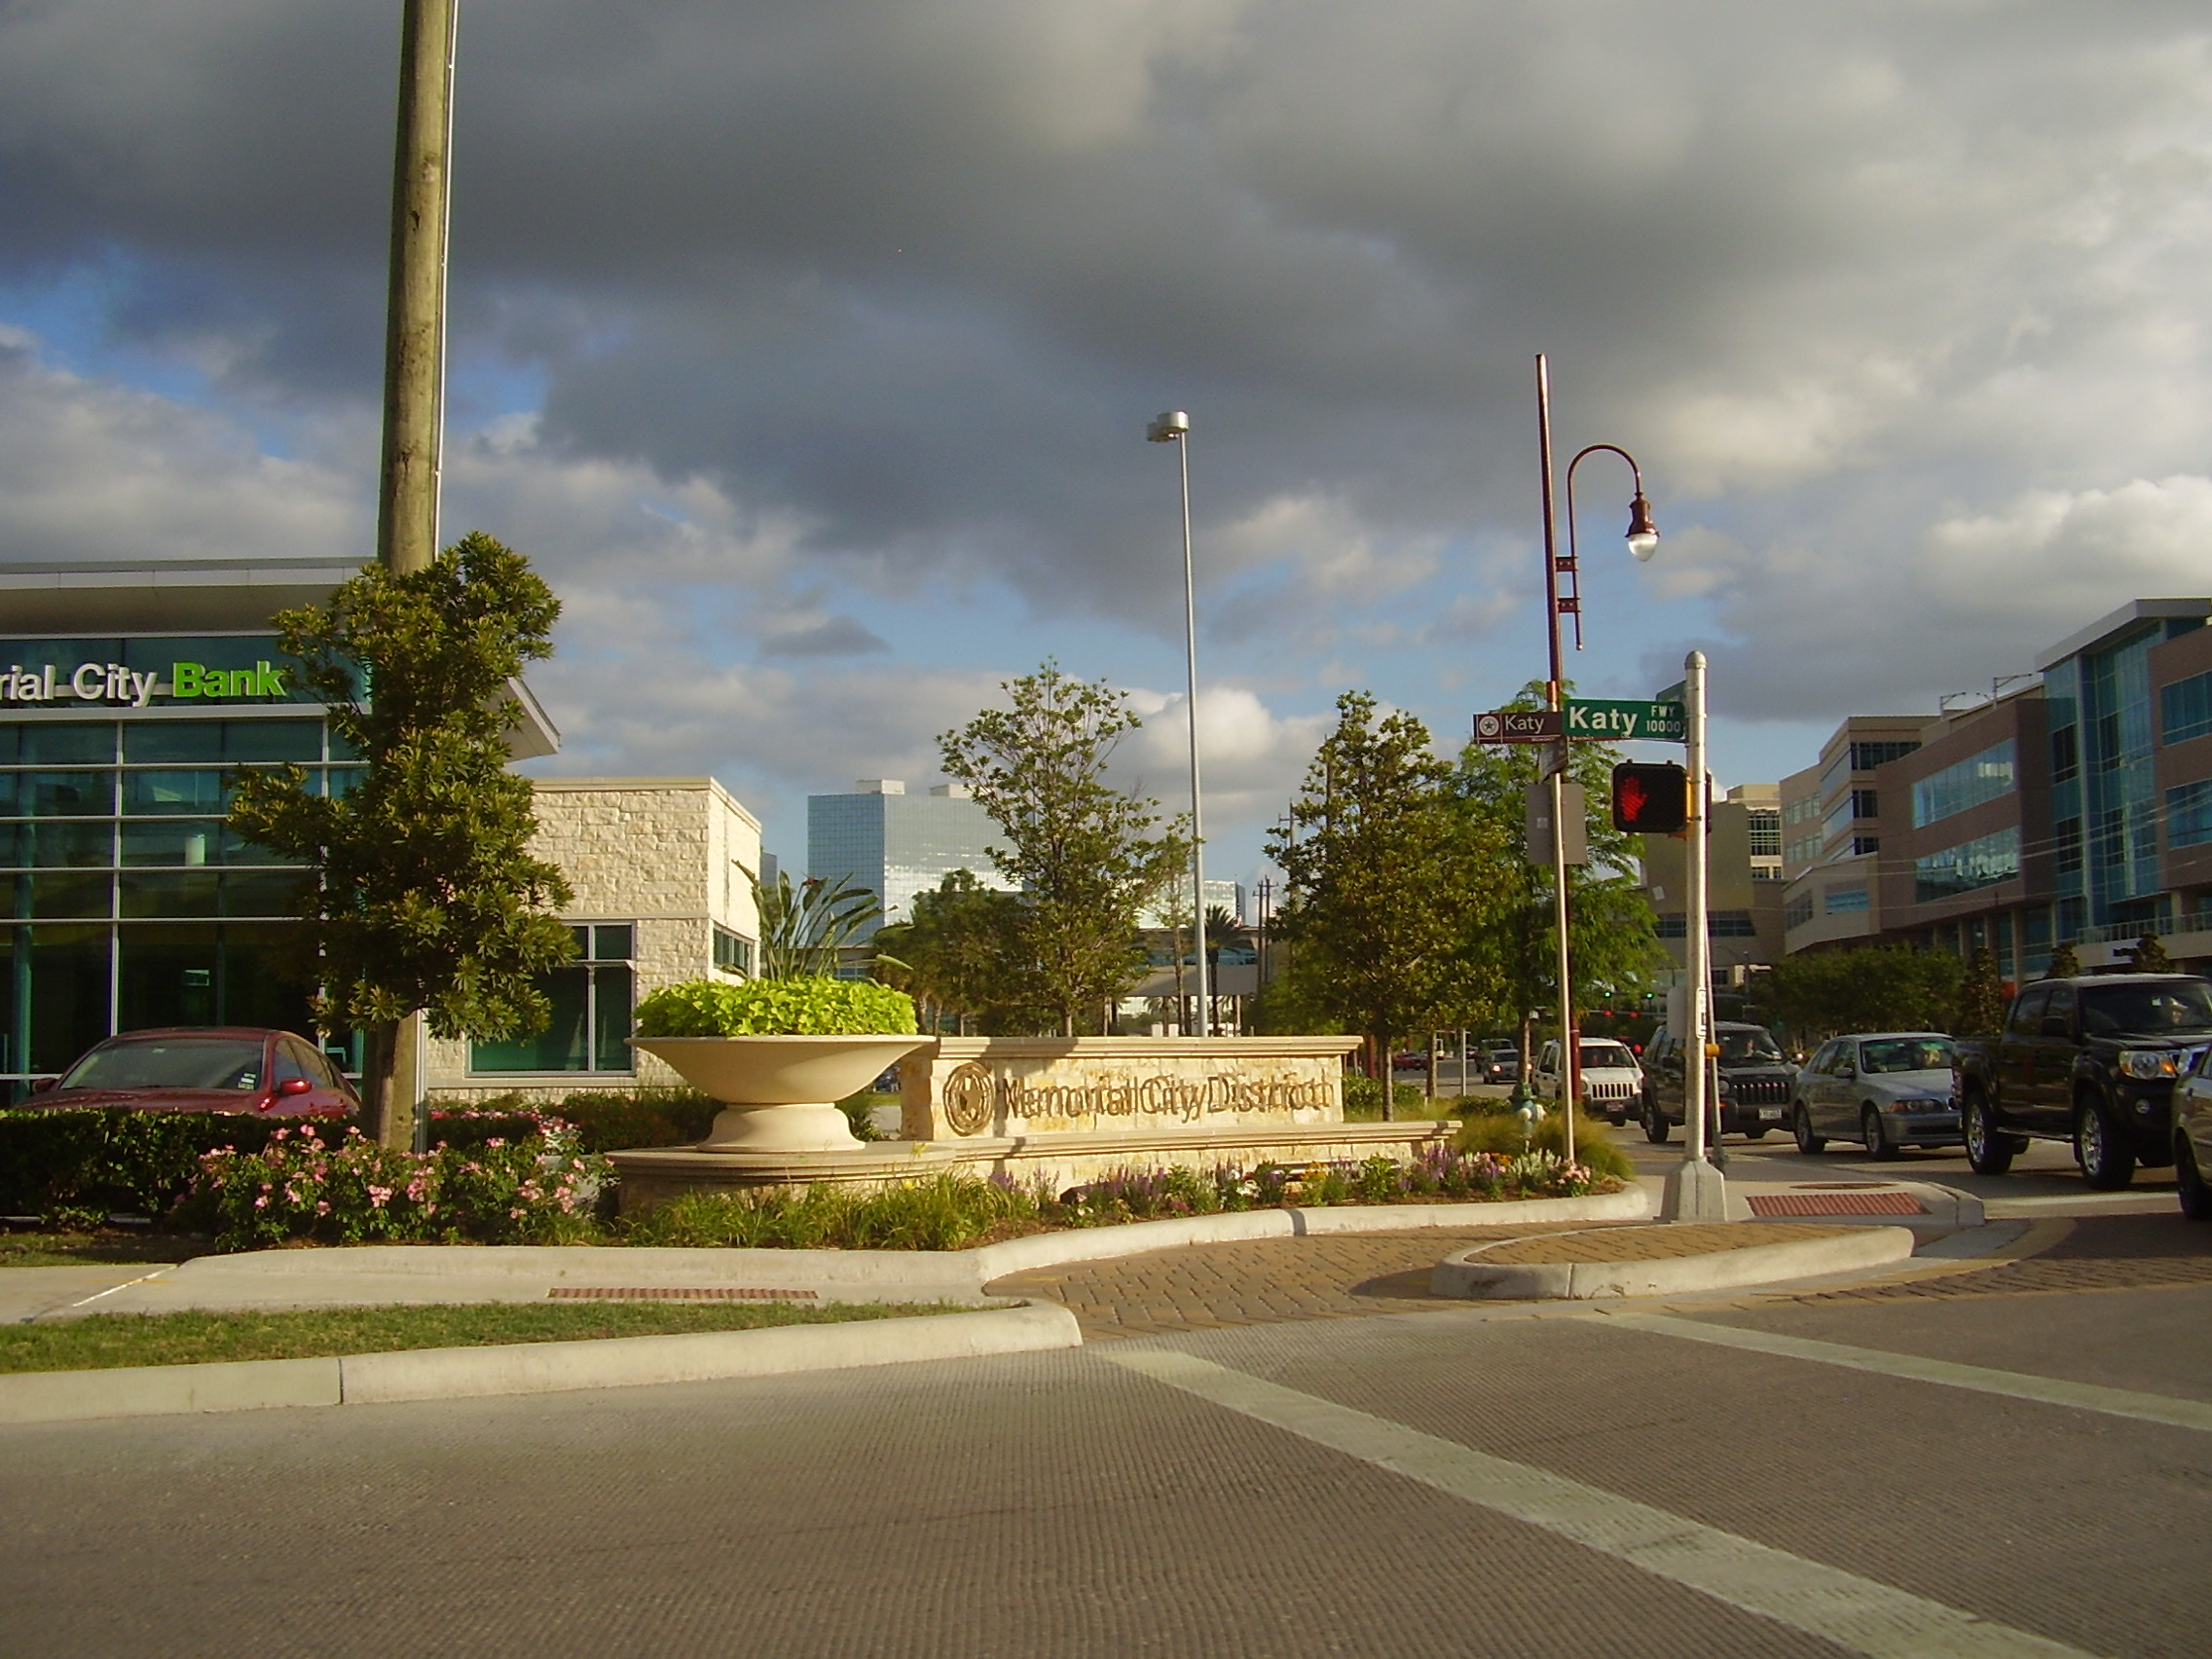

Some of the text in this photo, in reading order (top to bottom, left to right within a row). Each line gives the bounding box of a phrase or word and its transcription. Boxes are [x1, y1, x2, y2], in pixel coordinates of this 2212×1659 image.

[73, 662, 158, 708] City
[172, 660, 286, 698] Bank
[1504, 714, 1544, 734] Katy
[1568, 706, 1638, 737] Katy
[1650, 705, 1675, 718] FWY
[1645, 719, 1681, 732] 10000
[1003, 1069, 1335, 1124] Memorial City District
